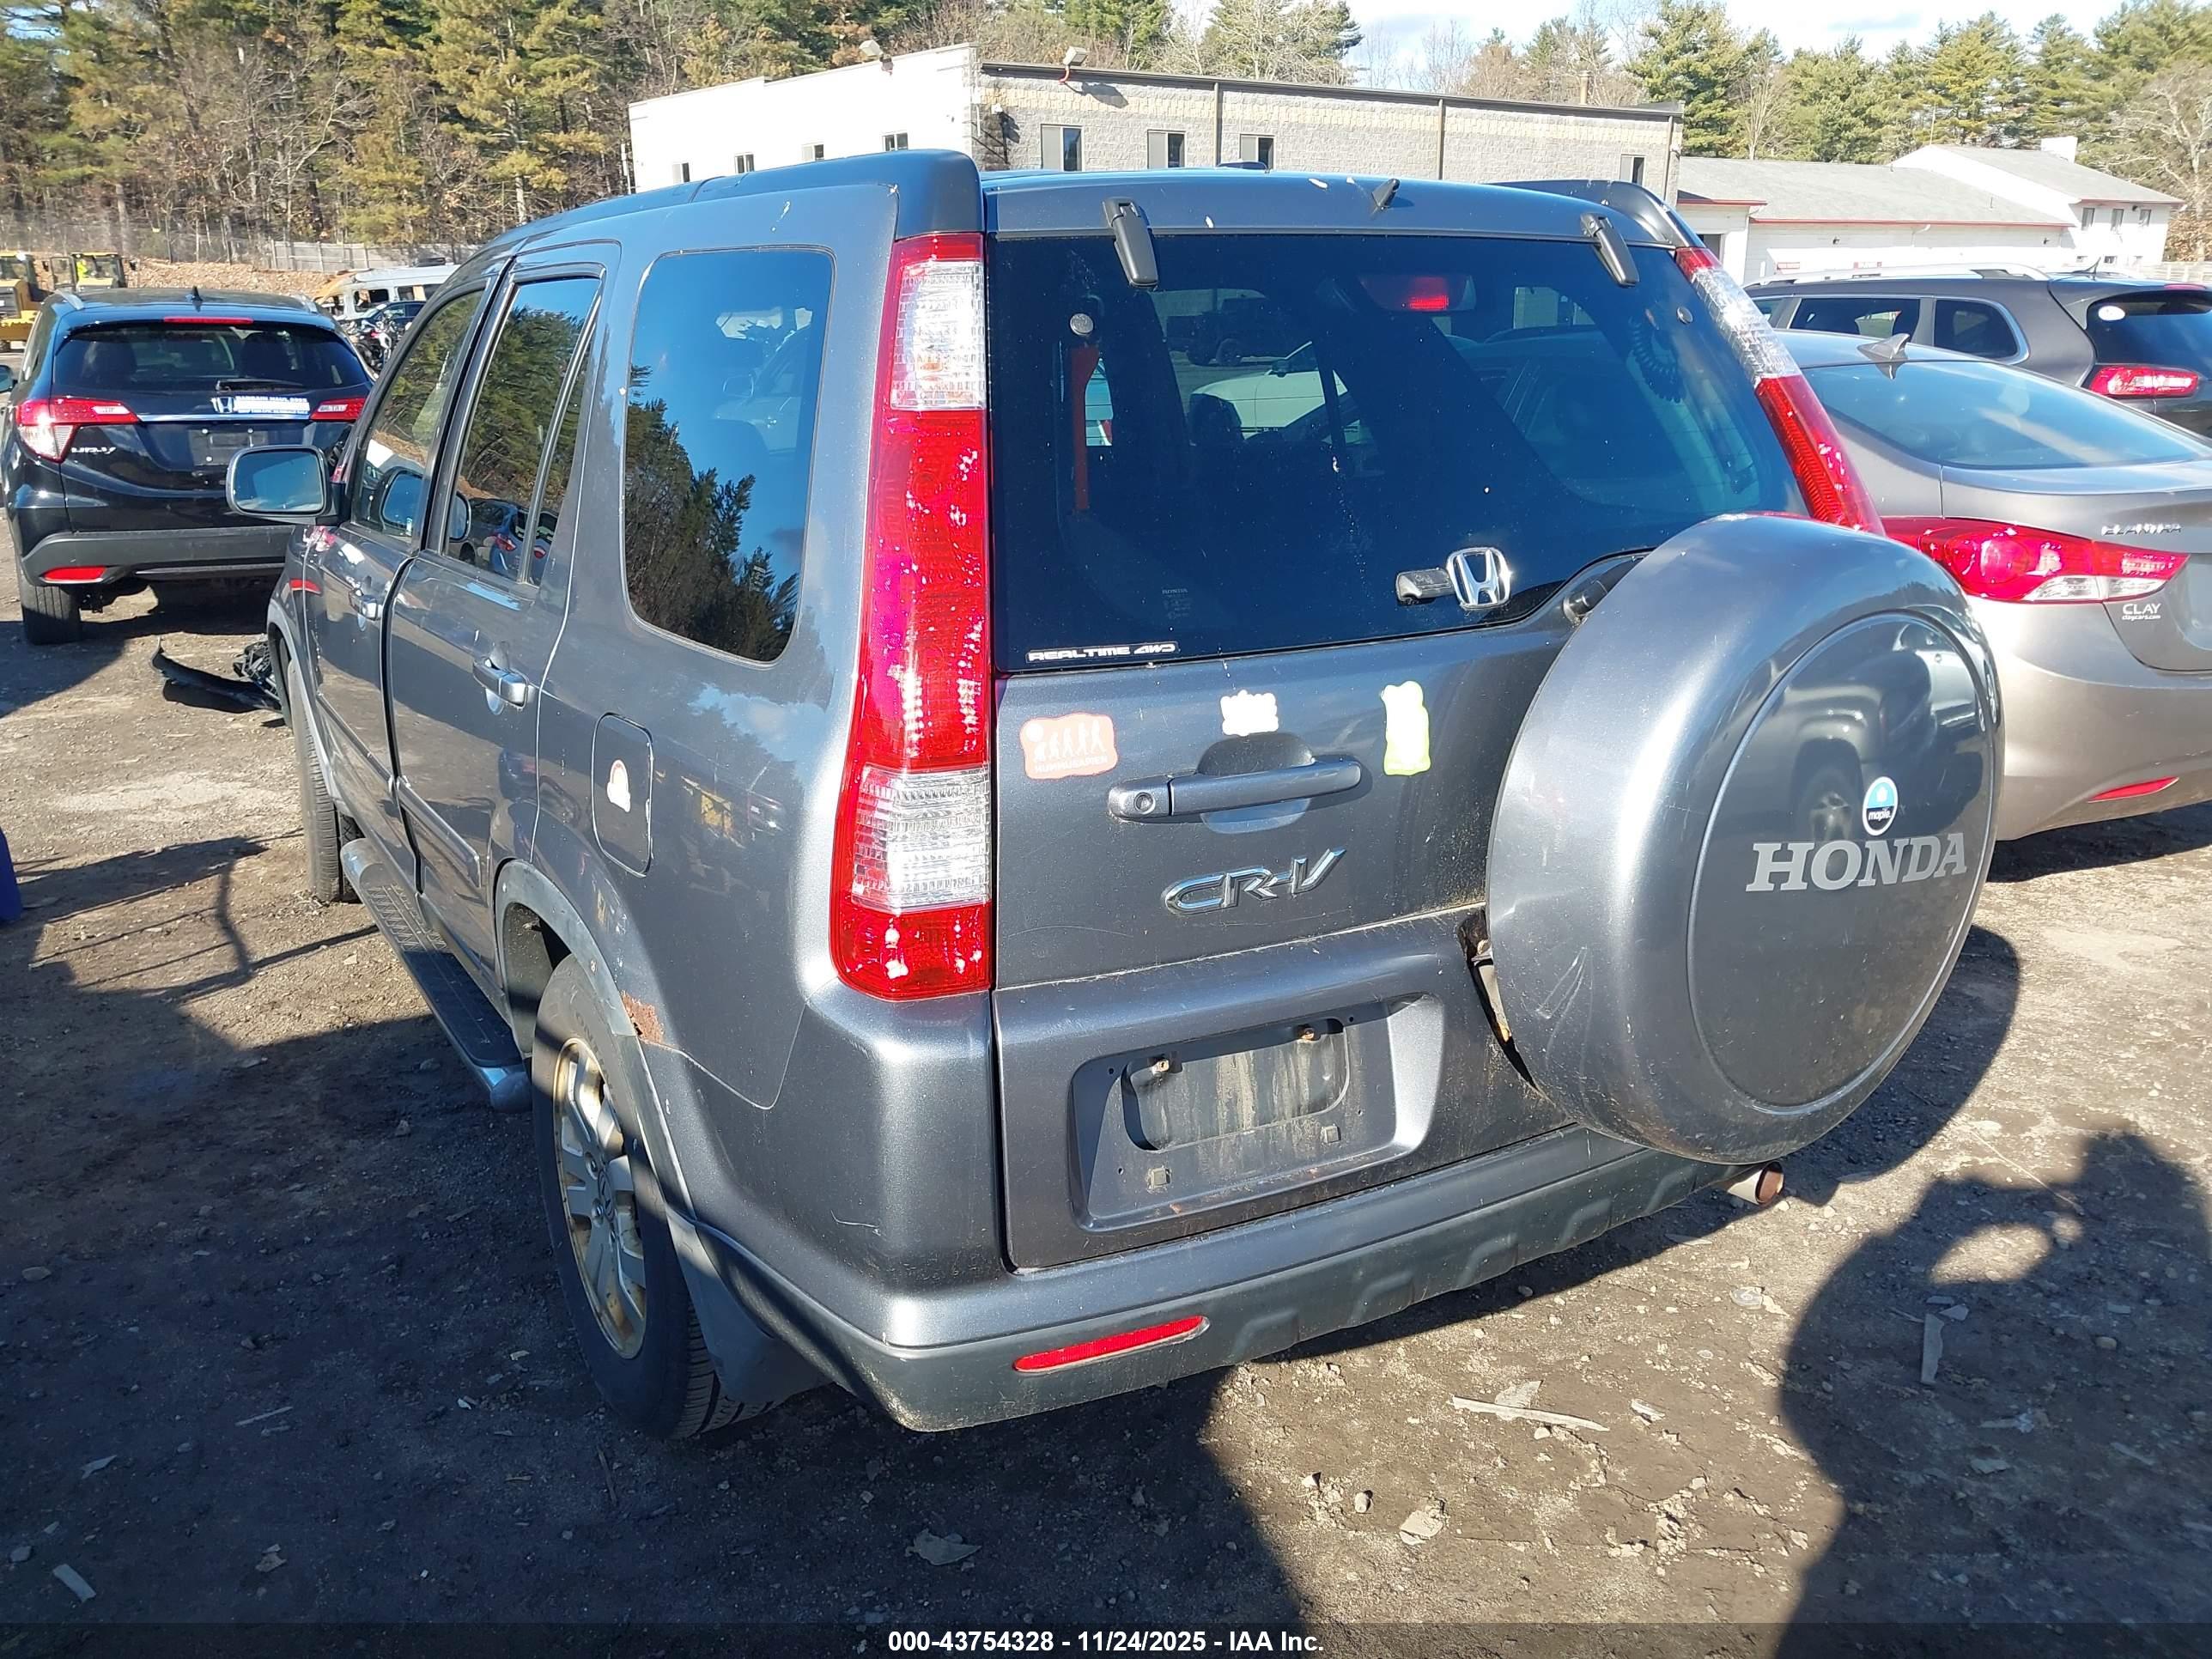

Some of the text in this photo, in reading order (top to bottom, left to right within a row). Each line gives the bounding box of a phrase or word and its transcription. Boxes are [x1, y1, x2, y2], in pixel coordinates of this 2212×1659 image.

[2122, 603, 2161, 615] CLAY
[1133, 643, 1176, 654] 4WD
[1745, 832, 1967, 892] HONDA
[1164, 847, 1346, 915] CR-V
